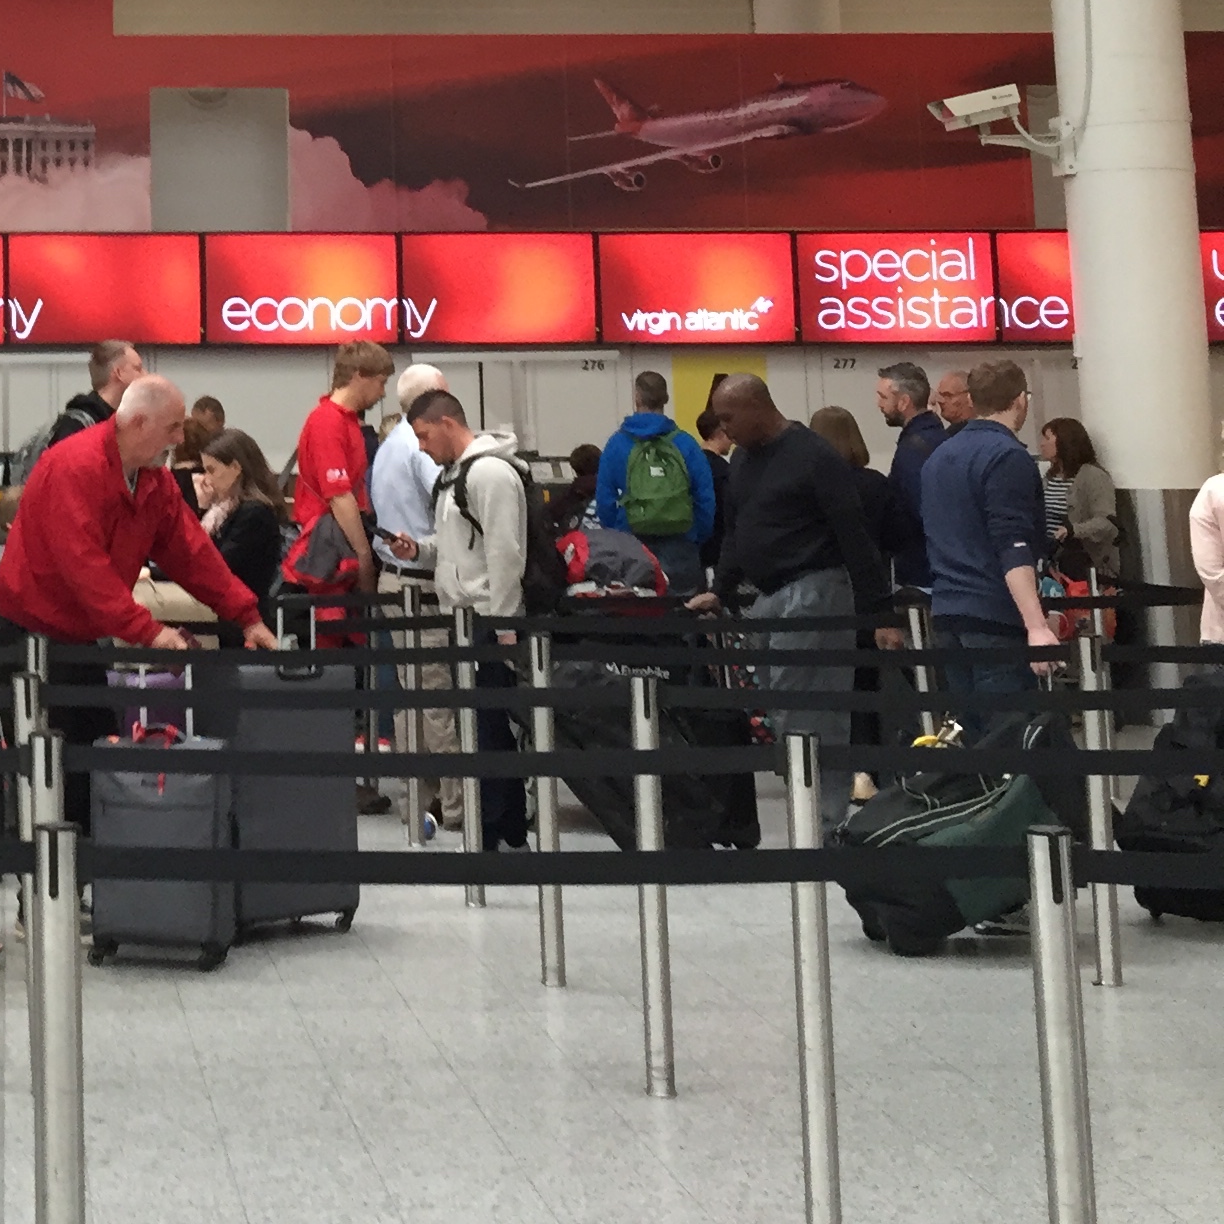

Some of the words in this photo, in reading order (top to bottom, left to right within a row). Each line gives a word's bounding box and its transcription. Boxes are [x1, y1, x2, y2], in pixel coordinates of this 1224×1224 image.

[814, 237, 976, 290] special
[221, 296, 438, 338] economy
[621, 308, 682, 336] virgin
[684, 307, 760, 331] atlantic
[817, 286, 1070, 329] assistance
[581, 359, 605, 371] 276
[833, 358, 856, 369] 277
